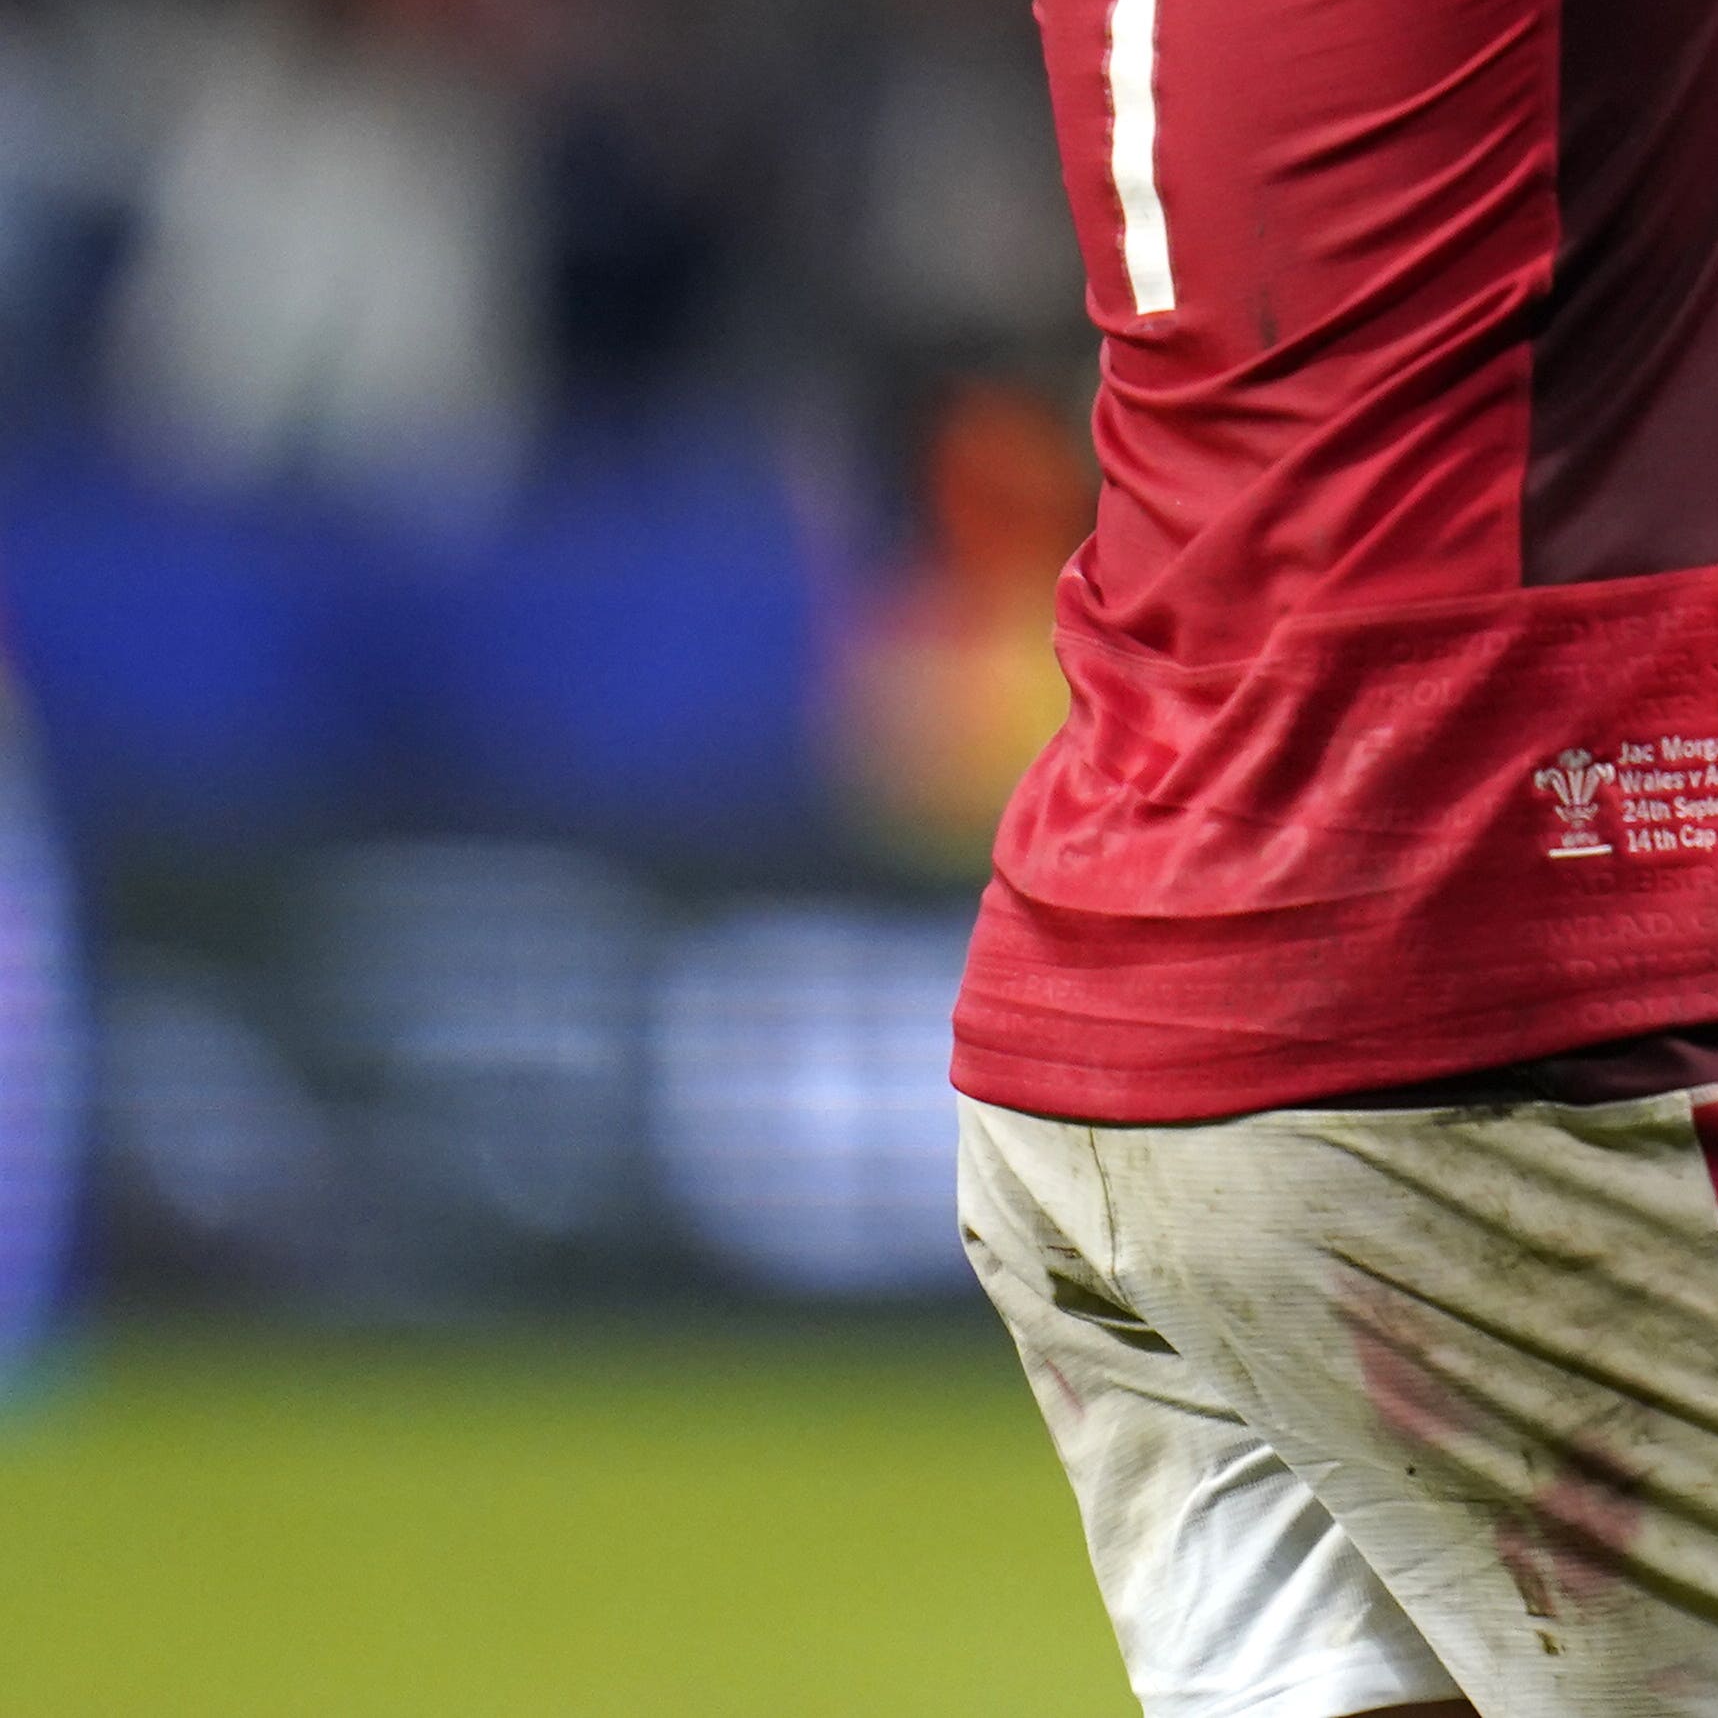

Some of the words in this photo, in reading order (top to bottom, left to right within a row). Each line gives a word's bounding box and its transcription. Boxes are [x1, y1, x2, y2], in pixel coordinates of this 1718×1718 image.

[1617, 741, 1655, 765] Jac
[1619, 767, 1686, 794] Wales
[1687, 770, 1703, 788] v
[1622, 798, 1672, 823] 24th
[1679, 823, 1718, 852] Cap
